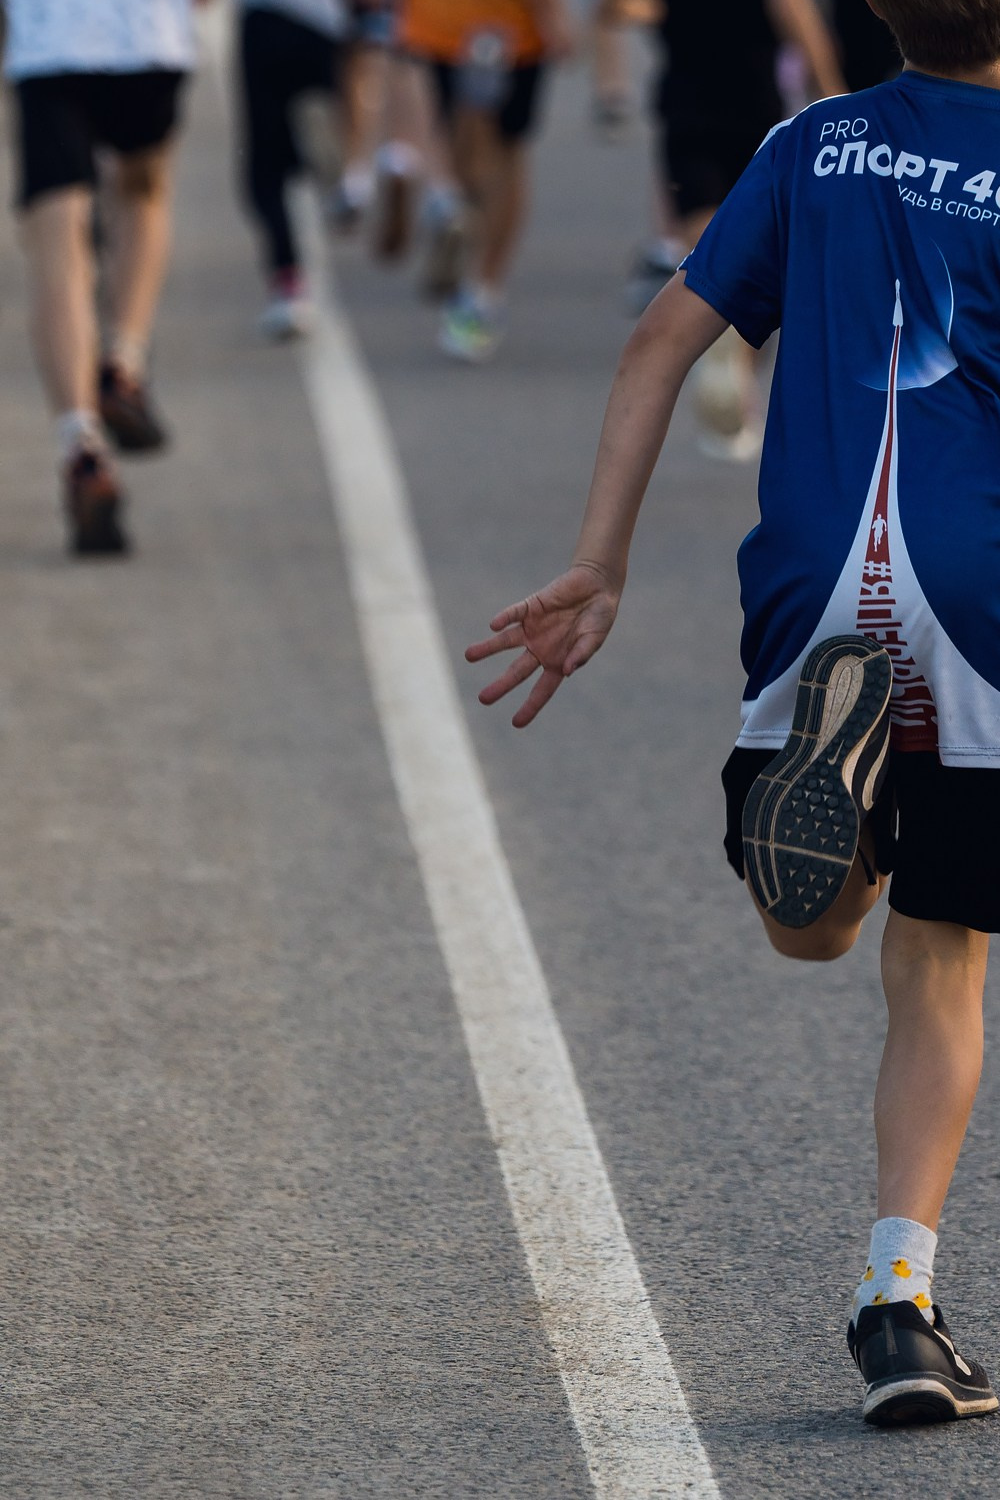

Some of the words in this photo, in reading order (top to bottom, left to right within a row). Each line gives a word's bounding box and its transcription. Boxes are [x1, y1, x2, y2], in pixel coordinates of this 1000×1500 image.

[819, 117, 868, 142] PRO
[813, 141, 959, 193] СПОРТ
[897, 184, 928, 208] УДЬ
[930, 197, 943, 211] В
